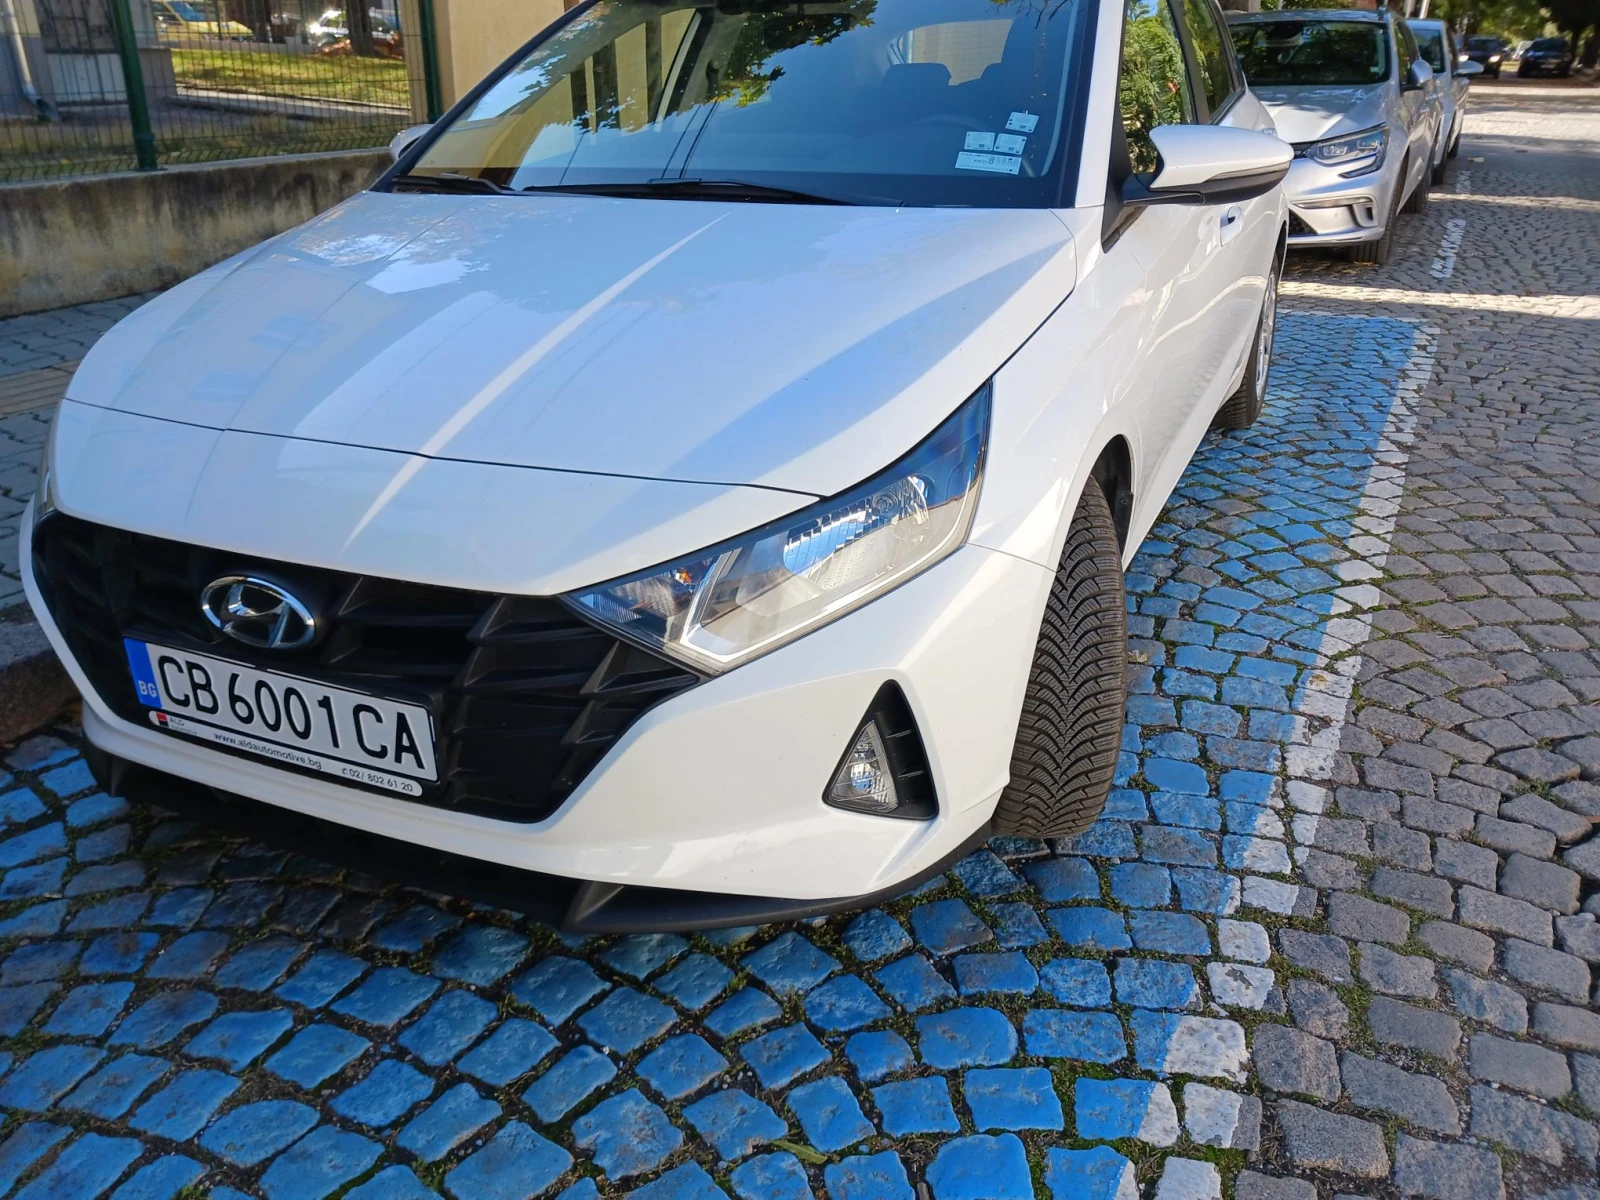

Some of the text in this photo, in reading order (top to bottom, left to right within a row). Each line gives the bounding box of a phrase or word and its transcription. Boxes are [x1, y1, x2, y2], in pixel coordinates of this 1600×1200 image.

[138, 680, 157, 698] BG
[158, 655, 426, 769] CB 6001 CA
[213, 733, 322, 770] www.aldautomotive.bg
[367, 773, 385, 785] 802
[387, 778, 398, 788] 61
[401, 782, 413, 792] 20
